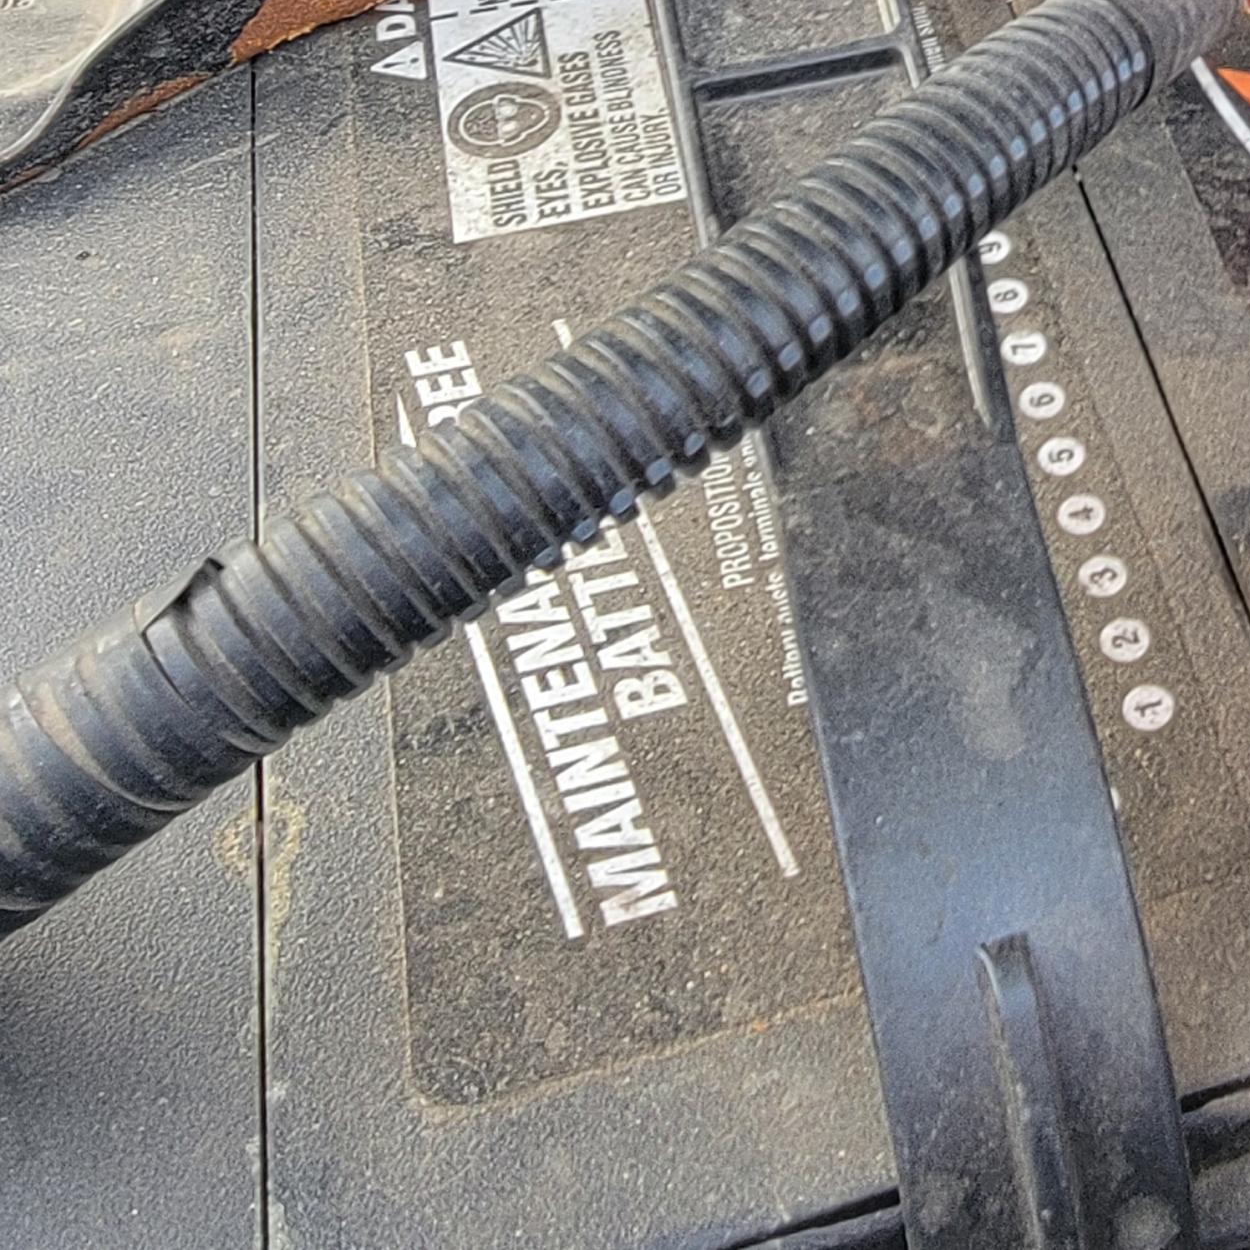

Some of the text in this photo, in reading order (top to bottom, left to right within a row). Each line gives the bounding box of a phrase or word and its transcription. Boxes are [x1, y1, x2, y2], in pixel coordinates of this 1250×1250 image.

[487, 159, 528, 228] SHIELD
[557, 51, 616, 211] EXPLOSIVE GASES
[592, 29, 650, 202] CAN CAUSE BLINDNESS
[651, 168, 683, 197] OR
[562, 515, 688, 720] BATTE
[495, 562, 678, 927] MAINTENA
